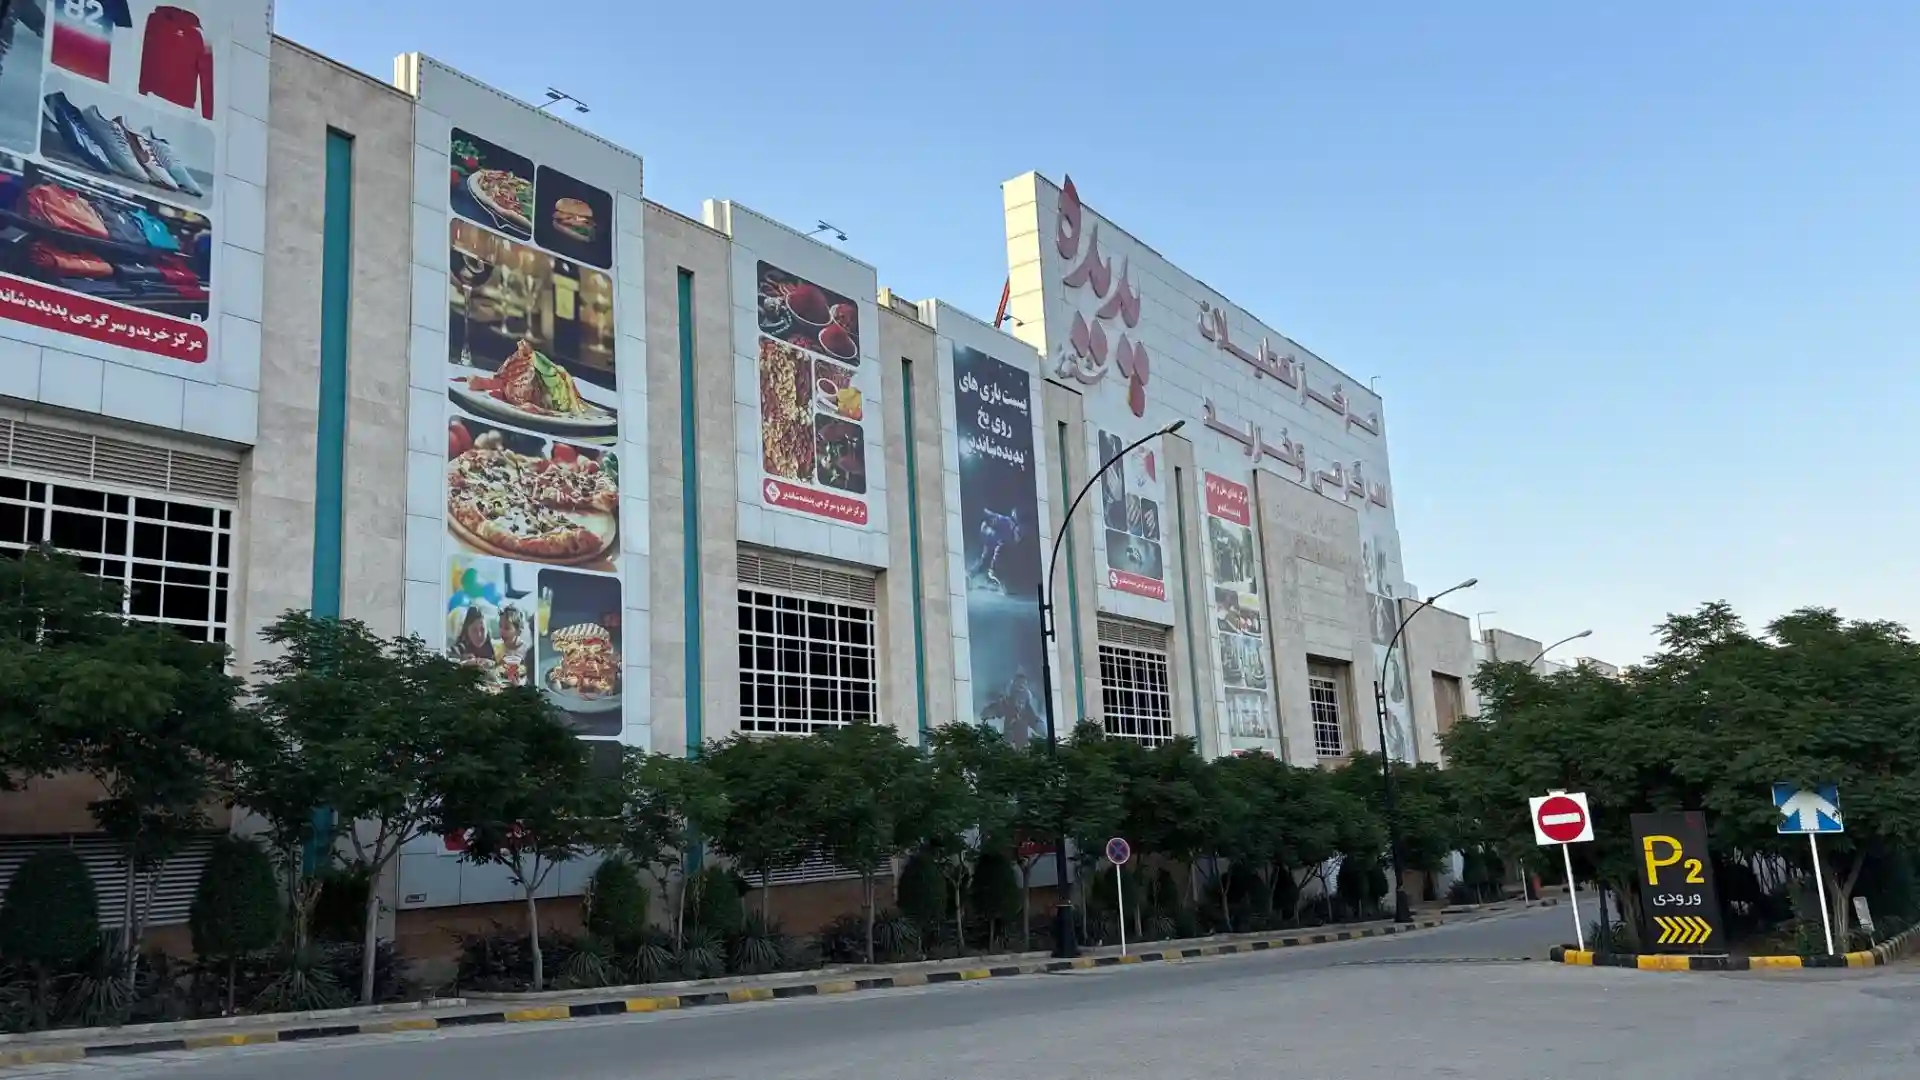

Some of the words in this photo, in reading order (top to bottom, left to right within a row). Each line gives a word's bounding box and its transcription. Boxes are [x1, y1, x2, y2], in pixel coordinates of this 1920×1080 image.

[0, 287, 27, 307] شاند
[28, 297, 68, 321] پدیده
[70, 313, 127, 334] سرگرمی
[128, 327, 136, 338] و
[136, 326, 169, 343] خرید
[172, 331, 203, 351] مرکز
[1197, 300, 1297, 390] تعطیلات
[958, 371, 979, 393] های
[979, 382, 1001, 407] بازی
[1002, 390, 1028, 416] پیست
[1297, 361, 1379, 437] مرکز
[977, 405, 990, 431] یخ
[991, 416, 1012, 439] روی
[1203, 397, 1295, 466] خرید
[996, 446, 1026, 471] پدیده
[1653, 893, 1702, 906] ورودی
